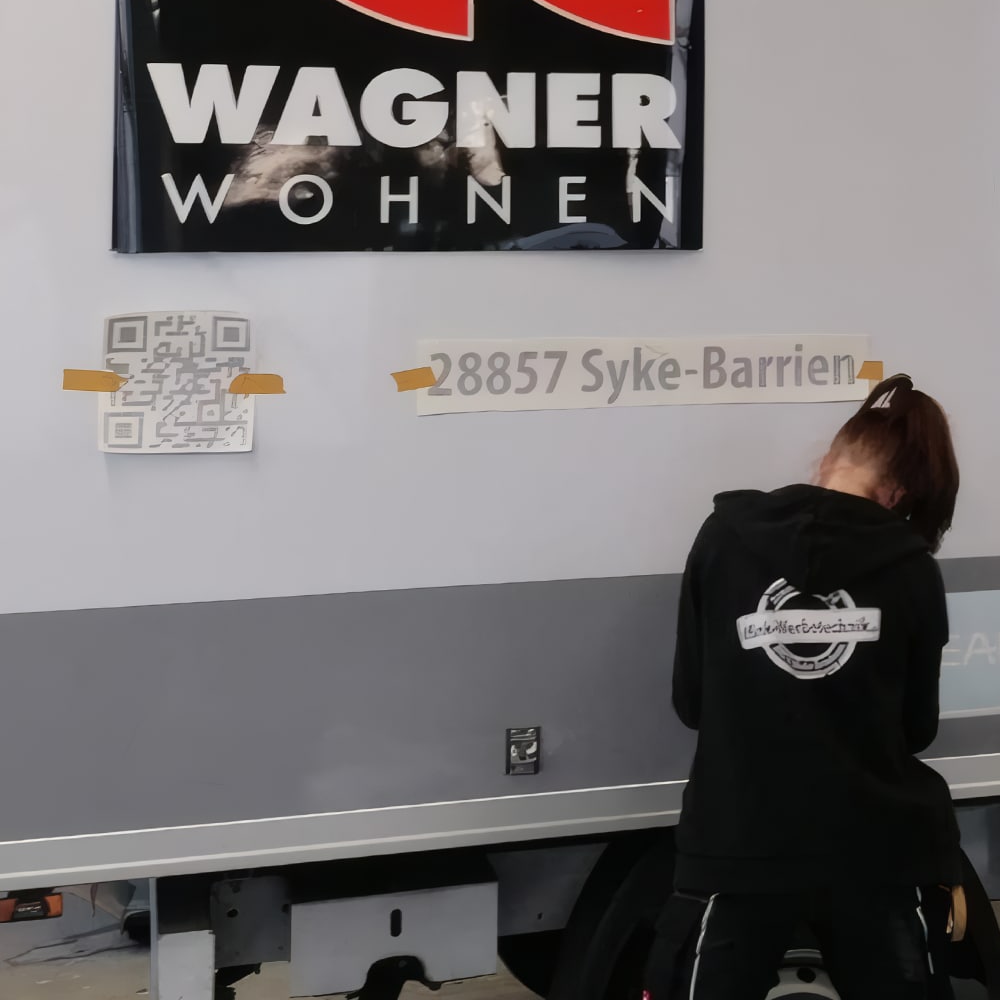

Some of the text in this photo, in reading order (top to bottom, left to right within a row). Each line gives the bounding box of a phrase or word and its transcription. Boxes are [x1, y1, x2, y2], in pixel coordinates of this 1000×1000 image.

[145, 62, 683, 151] WAGNER
[160, 172, 676, 225] WOHNEN
[426, 343, 857, 405] 28857 Syke-Barrien
